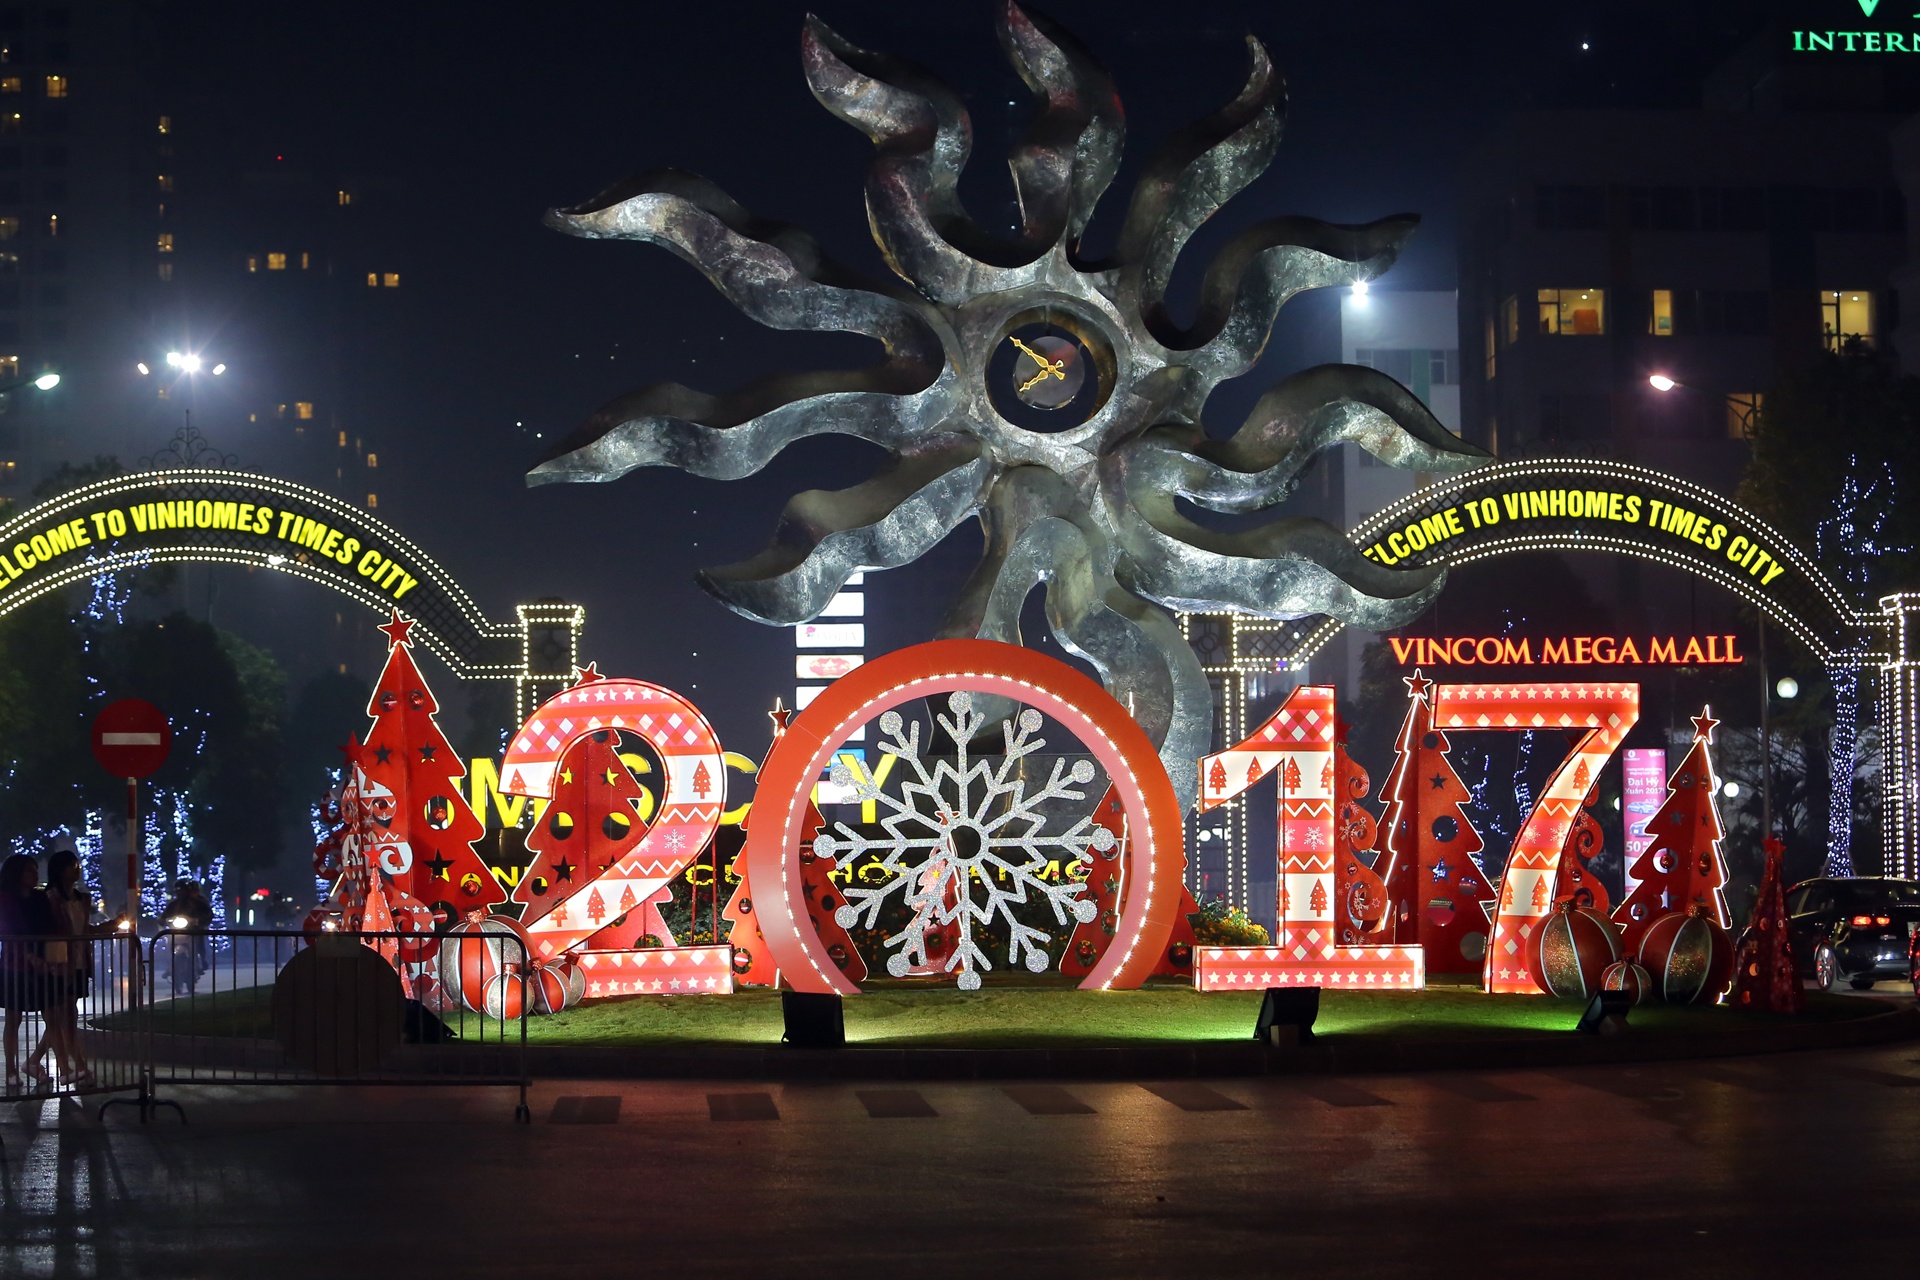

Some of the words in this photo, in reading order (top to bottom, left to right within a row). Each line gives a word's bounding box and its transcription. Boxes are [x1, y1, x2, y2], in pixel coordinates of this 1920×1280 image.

[1792, 31, 1920, 53] INTER
[90, 509, 127, 540] TO
[129, 499, 274, 535] VINHOMES
[277, 510, 361, 565] TIMES
[357, 549, 418, 599] CITY
[1463, 497, 1500, 529] TO
[1502, 489, 1642, 523] VINHOMES
[1648, 499, 1728, 551] TIMES
[1726, 535, 1785, 586] CITY
[1388, 636, 1534, 666] VINCOM
[1540, 636, 1644, 665] MEGA
[1647, 635, 1744, 664] MALL
[1625, 840, 1641, 853] 50
